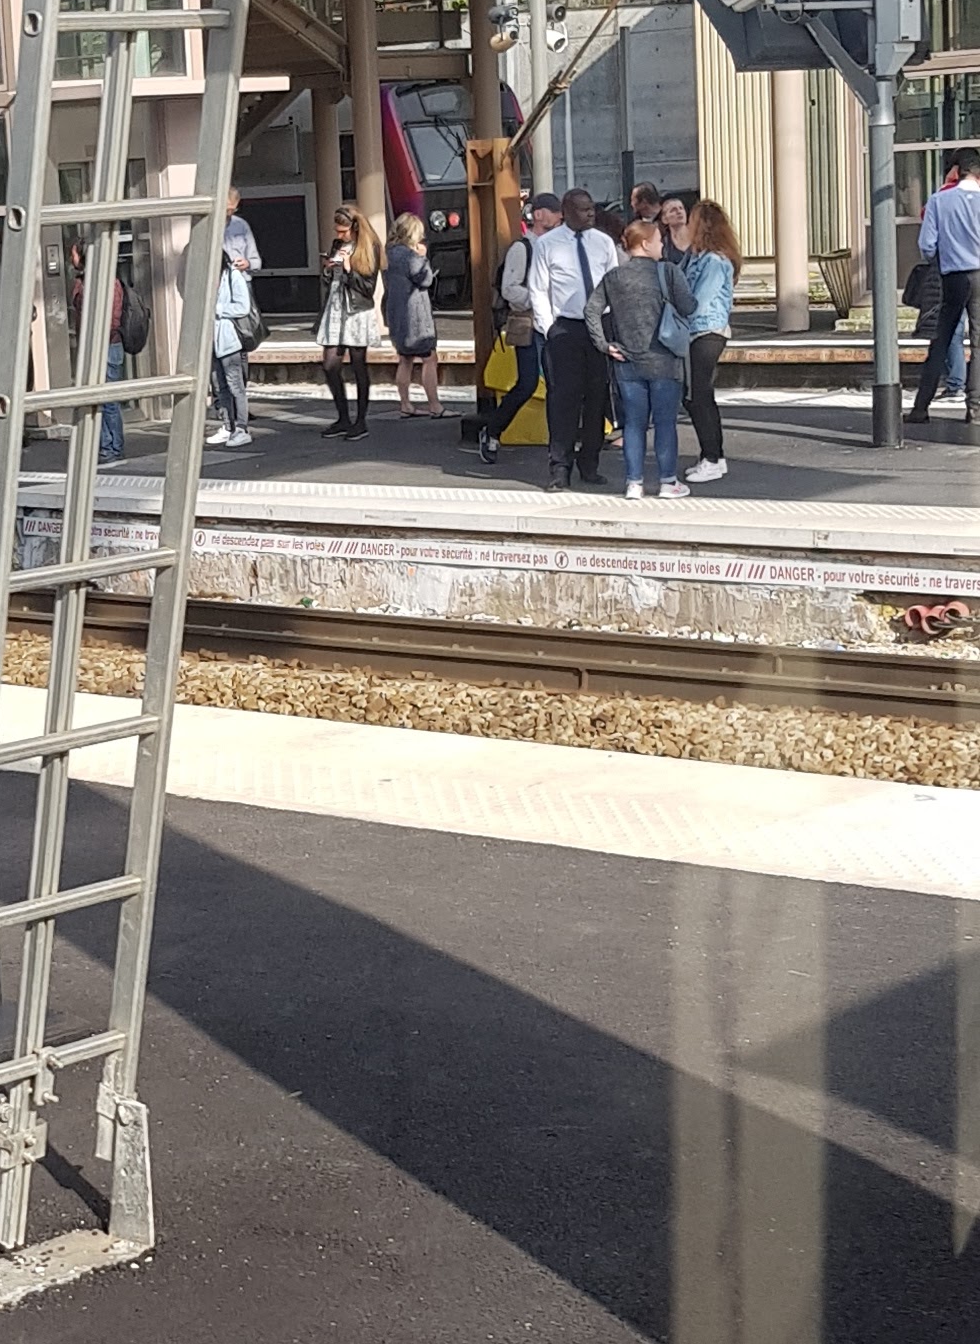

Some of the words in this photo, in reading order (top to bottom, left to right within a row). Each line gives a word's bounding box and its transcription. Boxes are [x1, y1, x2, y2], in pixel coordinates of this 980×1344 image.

[360, 542, 394, 556] DANGER
[492, 549, 531, 563] traversez
[533, 554, 548, 566] pas
[576, 556, 587, 567] ne
[589, 554, 638, 569] descendez
[640, 561, 657, 576] pas
[659, 561, 675, 572] sur
[678, 559, 692, 574] les
[694, 561, 721, 576] voies
[769, 565, 815, 581] DANGER
[823, 570, 846, 585] pour
[848, 571, 875, 584] votre
[878, 571, 920, 587] sécurité
[929, 577, 942, 588] ne
